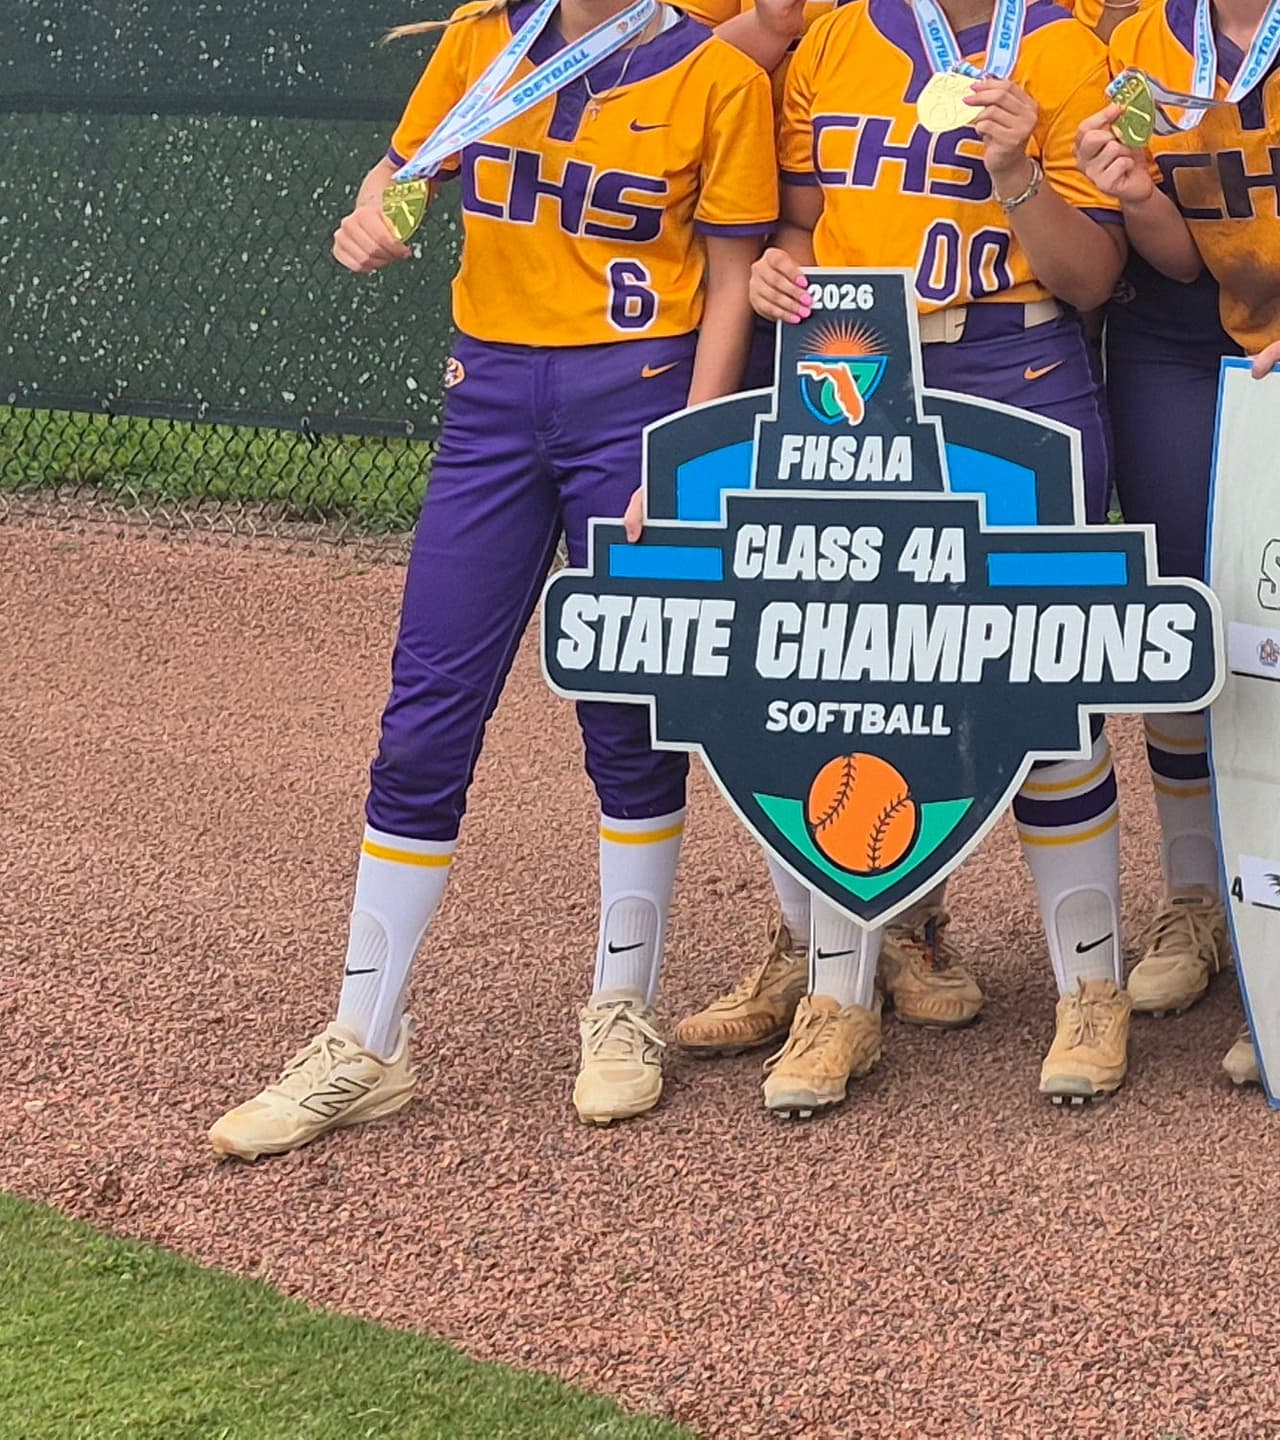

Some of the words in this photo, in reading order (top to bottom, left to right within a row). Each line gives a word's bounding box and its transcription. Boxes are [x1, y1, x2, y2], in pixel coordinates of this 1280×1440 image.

[512, 49, 590, 106] SOFTBALL
[811, 112, 993, 203] CHS
[461, 140, 669, 244] CHS
[914, 217, 1015, 304] 00
[606, 255, 660, 333] 6
[807, 283, 874, 310] 2026
[777, 434, 913, 482] FHSAA
[731, 523, 883, 583] CLASS
[896, 526, 967, 584] 4A
[555, 593, 736, 678] STATE
[753, 601, 1197, 684] CHAMPIONS
[764, 699, 952, 736] SOFTBALL
[1230, 875, 1245, 903] 4
